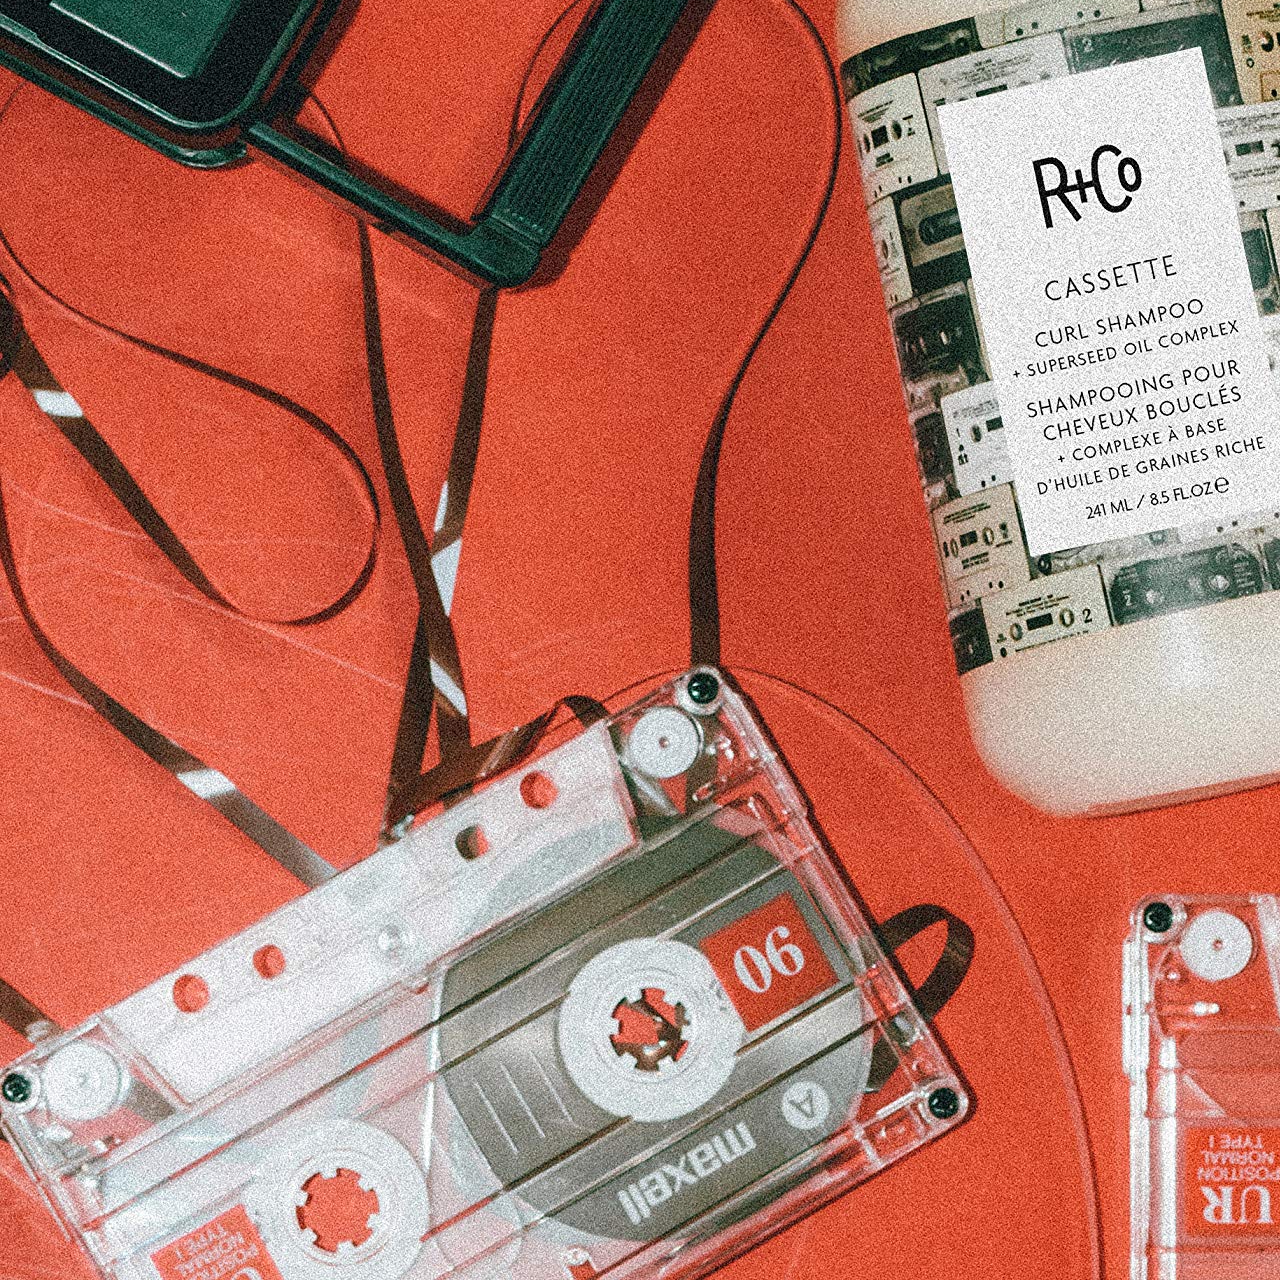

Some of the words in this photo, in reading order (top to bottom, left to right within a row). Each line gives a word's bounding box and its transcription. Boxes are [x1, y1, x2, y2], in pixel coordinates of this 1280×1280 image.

[1032, 144, 1142, 228] R+Co
[1044, 253, 1178, 302] CASSETTE
[1034, 324, 1089, 348] CURL
[1095, 297, 1205, 336] SHAMPOO
[1026, 346, 1117, 378] SUPERSEED
[1123, 339, 1153, 358] OIL
[1157, 319, 1240, 350] COMPLEX
[1026, 372, 1175, 419] SHAMPOOING
[1181, 359, 1242, 386] POUR
[1042, 406, 1139, 442] CHEVEUX
[1146, 384, 1243, 421] BOUCLÉS
[1071, 430, 1162, 463] COMPLEXE
[1185, 417, 1228, 440] BASE
[1108, 462, 1131, 481] DE
[1135, 447, 1209, 476] GRAINES
[1214, 435, 1266, 459] RICHE
[1085, 504, 1108, 520] 241
[1110, 497, 1133, 515] ML
[1149, 487, 1170, 506] 8.5
[1081, 608, 1093, 625] 2
[733, 925, 805, 994] 90
[1201, 1150, 1275, 1165] NORMAL
[1220, 1133, 1264, 1150] TYPE
[617, 1122, 756, 1225] maxell
[1200, 1185, 1274, 1225] UR
[175, 1231, 246, 1276] NORMAL
[187, 1223, 228, 1252] TYPE
